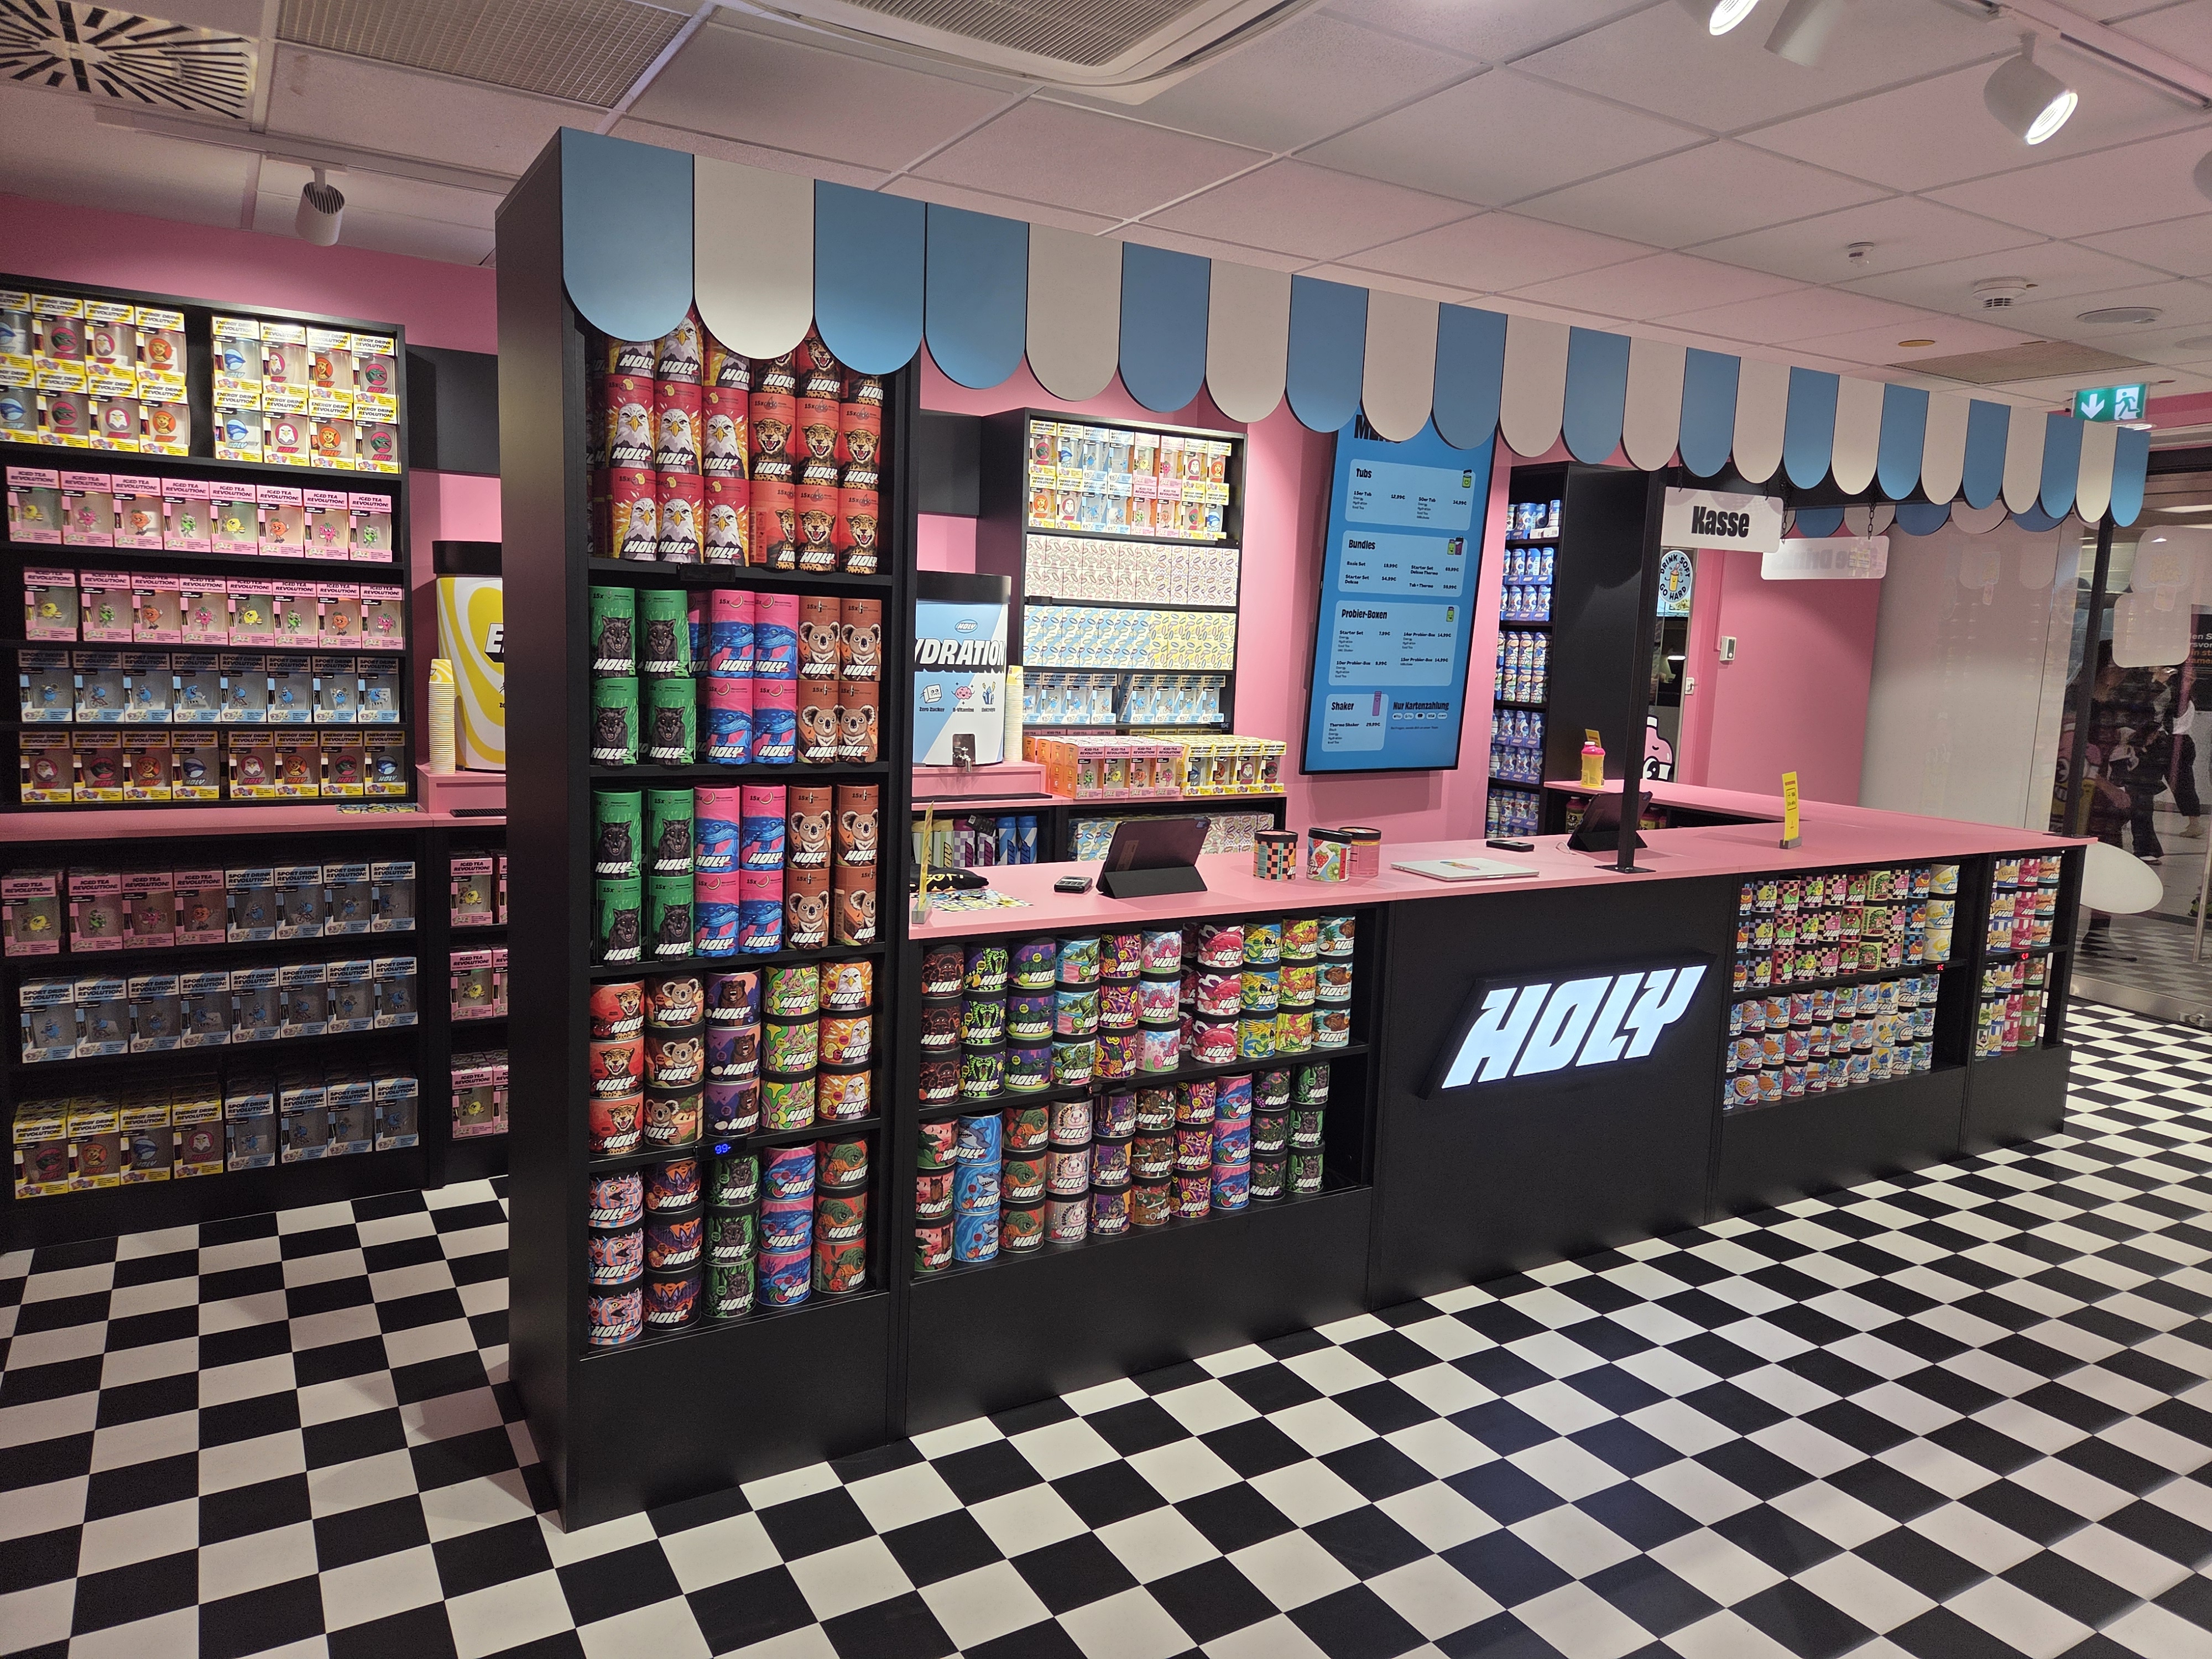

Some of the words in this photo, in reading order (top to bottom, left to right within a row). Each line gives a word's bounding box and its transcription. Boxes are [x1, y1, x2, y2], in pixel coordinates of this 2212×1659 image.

[660, 361, 698, 375] HOLY
[612, 447, 651, 461] HOLY
[656, 453, 693, 466] HOLY
[703, 458, 738, 471] HOLY
[754, 462, 791, 474] HOLY
[1357, 468, 1372, 478] Tubs
[1691, 505, 1750, 538] Kasse
[1349, 540, 1375, 550] Bundles
[705, 547, 739, 559] HOLY
[800, 552, 834, 564] HOLY
[1661, 554, 1678, 574] DRINK
[1679, 556, 1690, 577] SOFT
[1660, 583, 1668, 596] GO
[1670, 586, 1686, 600] HARD
[1342, 609, 1387, 619] Probier-Boxen
[594, 659, 633, 671] HOLY
[719, 660, 753, 671] HOLY
[799, 663, 835, 675] HOLY
[843, 666, 877, 676] HOLY
[1332, 702, 1354, 711] Shaker
[1393, 702, 1404, 710] Nur
[1405, 702, 1449, 711] Kartenzahlung
[709, 747, 743, 758] HOLY
[759, 746, 792, 758] HOLY
[696, 855, 729, 868] HOLY
[792, 852, 826, 863] HOLY
[595, 862, 632, 874] HOLY
[791, 932, 824, 943] HOLY
[928, 980, 961, 993] HOLY
[1320, 986, 1347, 996] HOLY
[830, 991, 864, 1004] HOLY
[658, 1007, 696, 1021] HOLY
[712, 1007, 750, 1020] HOLY
[1100, 1014, 1131, 1023] HOLY
[1143, 1008, 1173, 1018] HOLY
[967, 1027, 1000, 1039] HOLY
[1016, 1022, 1048, 1033] HOLY
[1441, 965, 1707, 1089] HOLY
[1205, 1047, 1233, 1057] HOLY
[1063, 1067, 1092, 1079] HOLY
[597, 1077, 635, 1091] HOLY
[1138, 1114, 1166, 1125] HOLY
[1060, 1127, 1089, 1139] HOLY
[1254, 1140, 1282, 1151] HOLY
[1099, 1168, 1127, 1181] HOLY
[1013, 1186, 1041, 1198] HOLY
[659, 1191, 697, 1208] HOLY
[589, 1207, 629, 1220] HOLY
[768, 1233, 804, 1248] HOLY
[596, 1265, 635, 1279] HOLY
